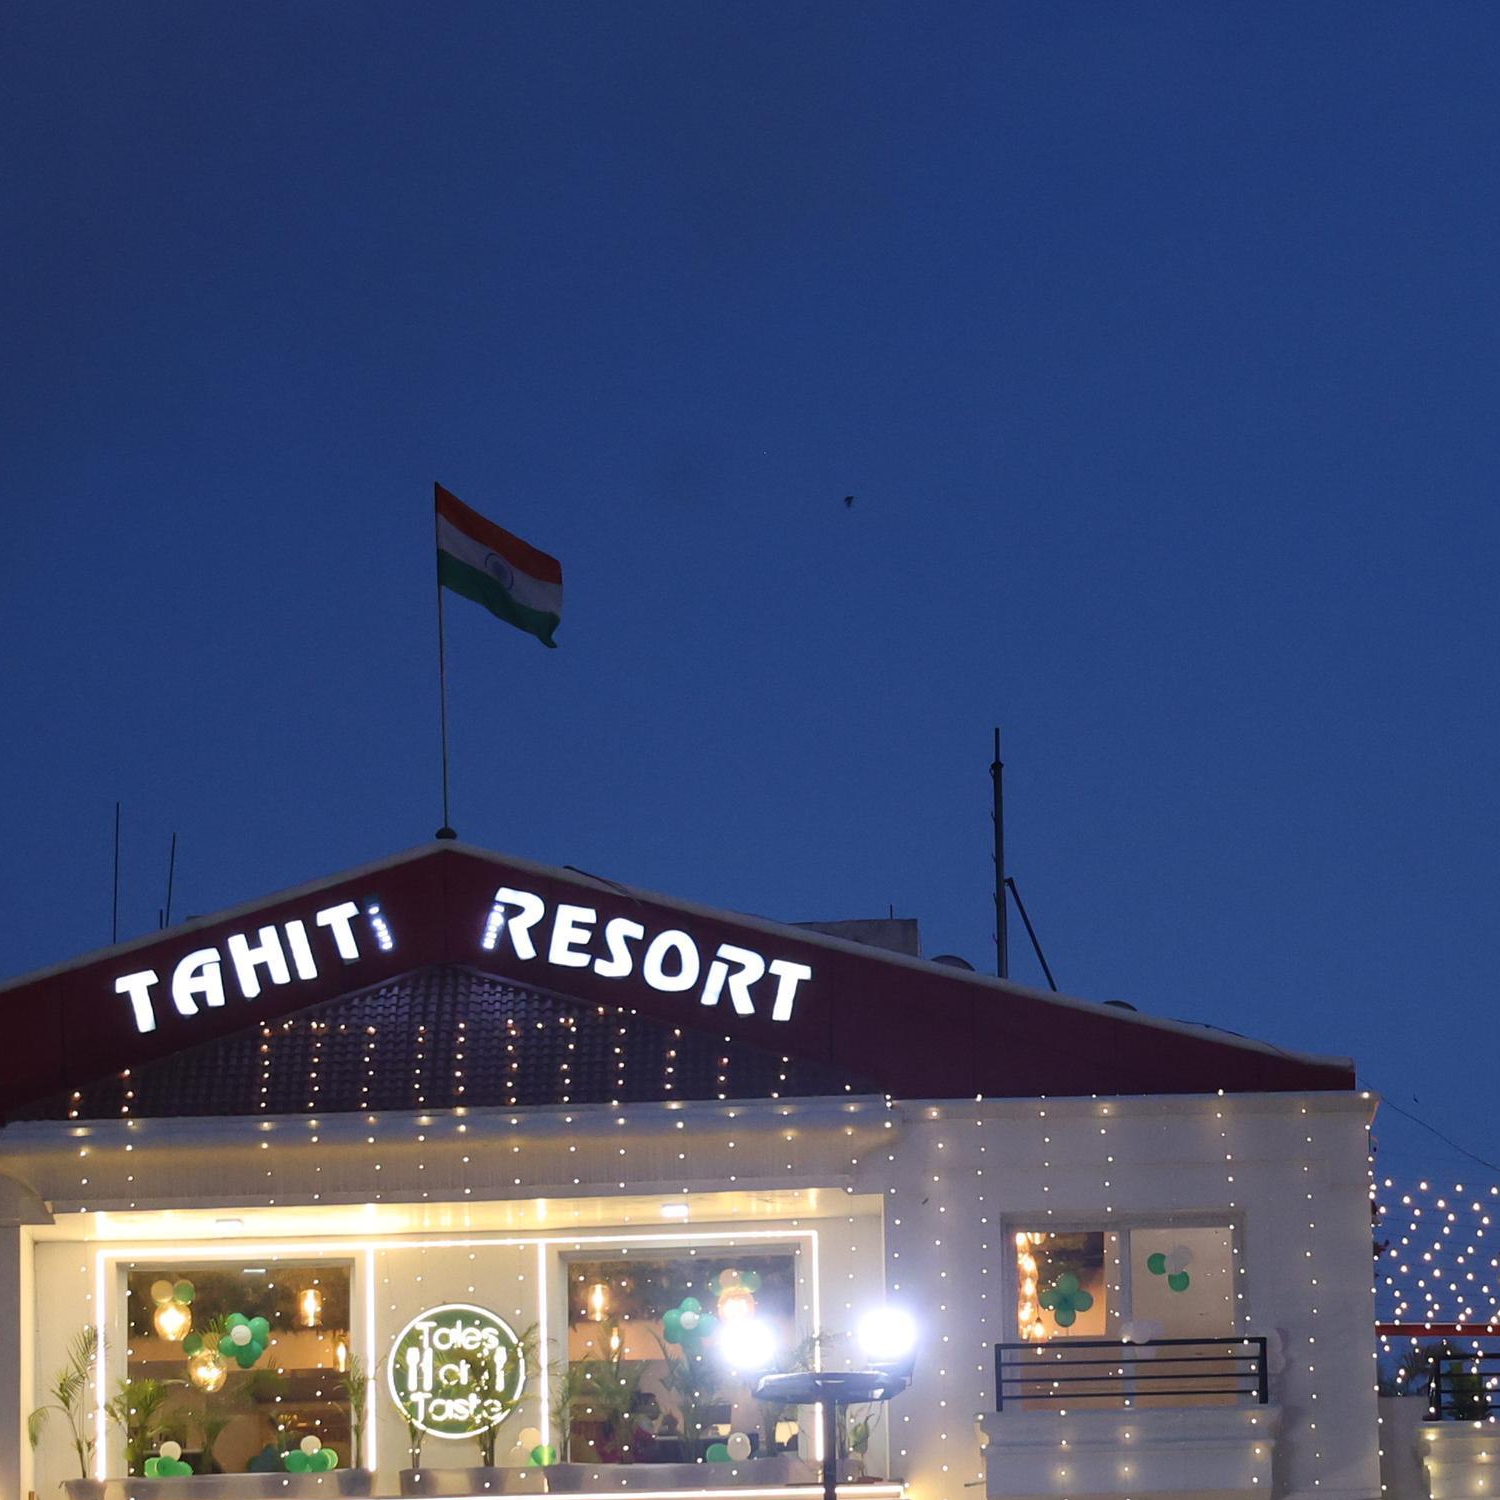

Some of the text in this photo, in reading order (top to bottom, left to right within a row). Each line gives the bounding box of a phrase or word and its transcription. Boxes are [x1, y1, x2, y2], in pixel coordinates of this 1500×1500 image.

[480, 886, 813, 1023] RESORT
[414, 1319, 500, 1350] Tales
[410, 1391, 502, 1422] Taste
